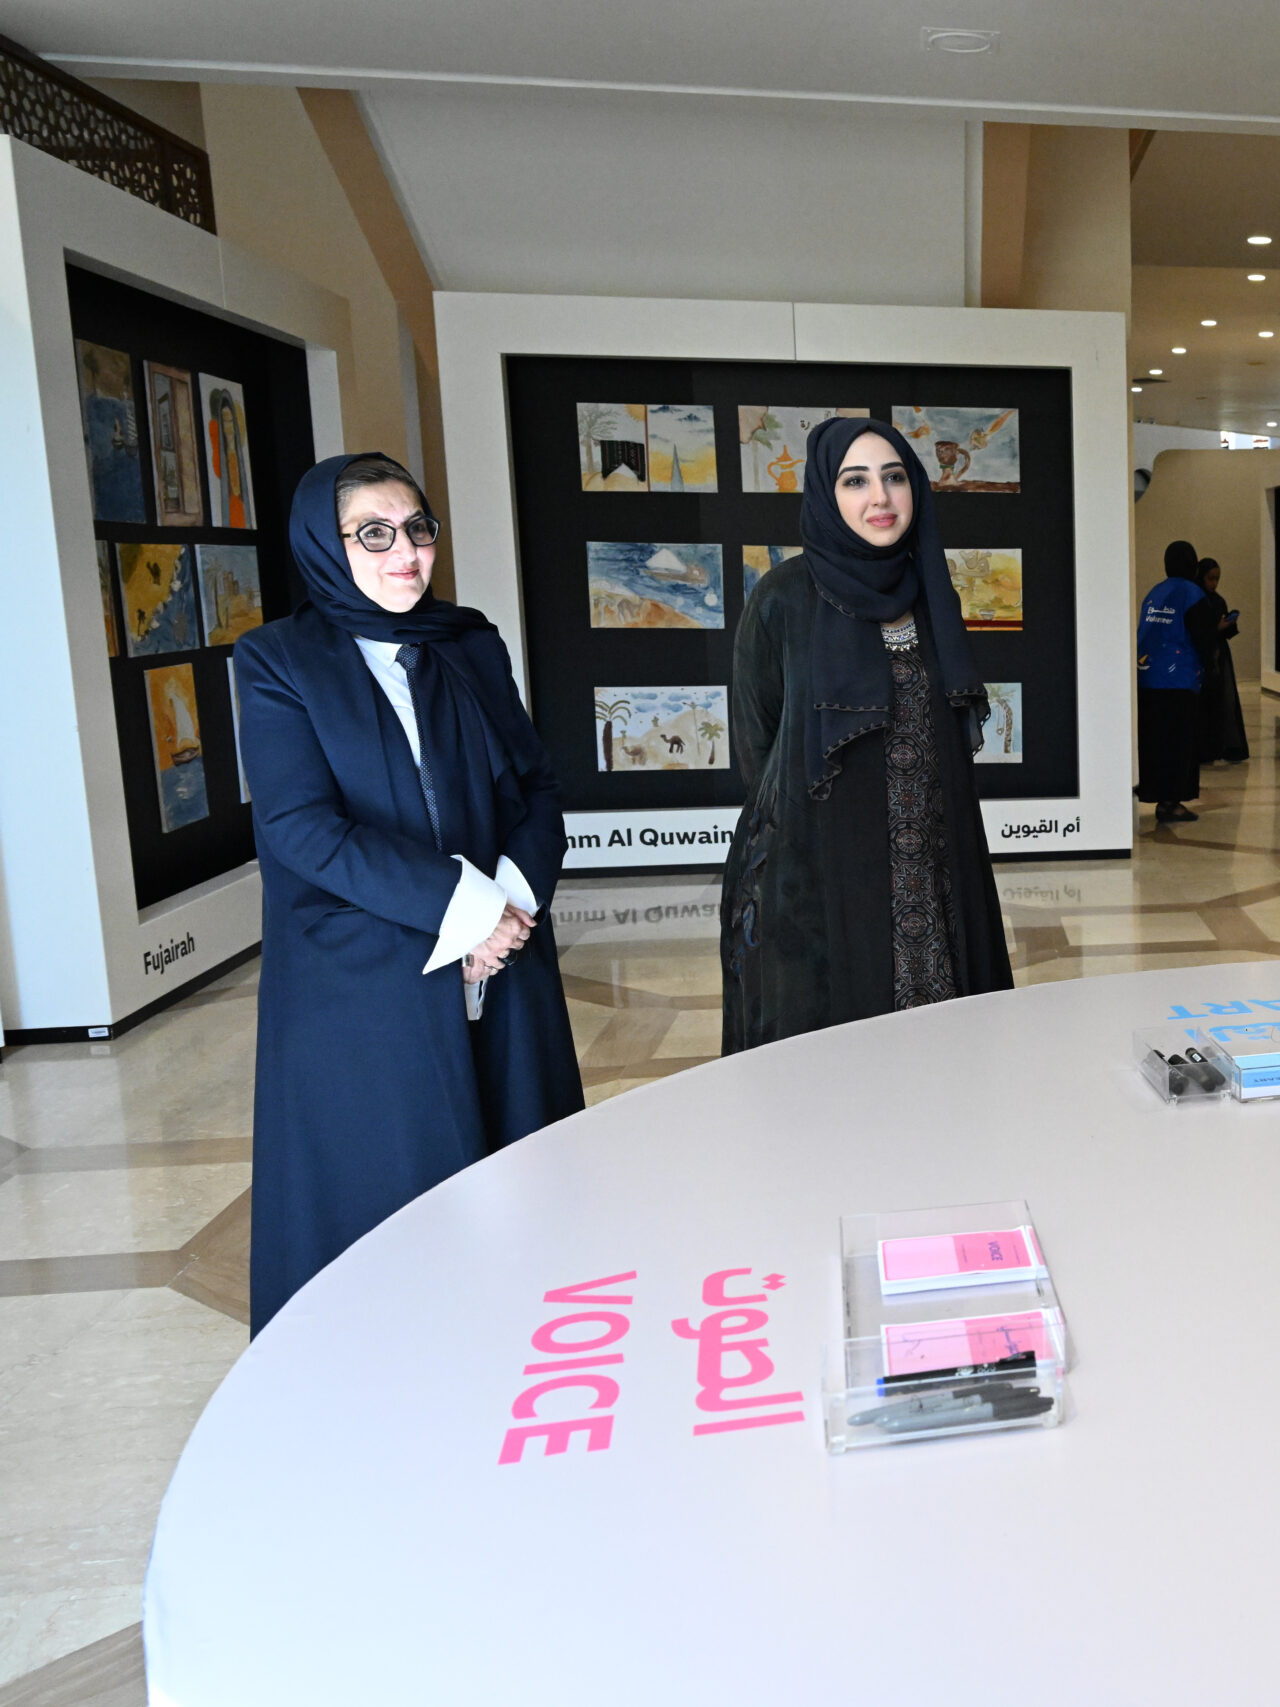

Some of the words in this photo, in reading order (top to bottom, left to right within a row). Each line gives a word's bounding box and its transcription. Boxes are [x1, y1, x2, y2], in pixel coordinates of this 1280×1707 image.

[607, 828, 633, 848] Al
[639, 824, 734, 848] Quwain
[1001, 819, 1059, 839] القيوين
[1062, 816, 1081, 838] أم
[143, 931, 195, 975] Fujairah
[497, 1270, 637, 1465] VOICE
[670, 1267, 806, 1436] الصوت
